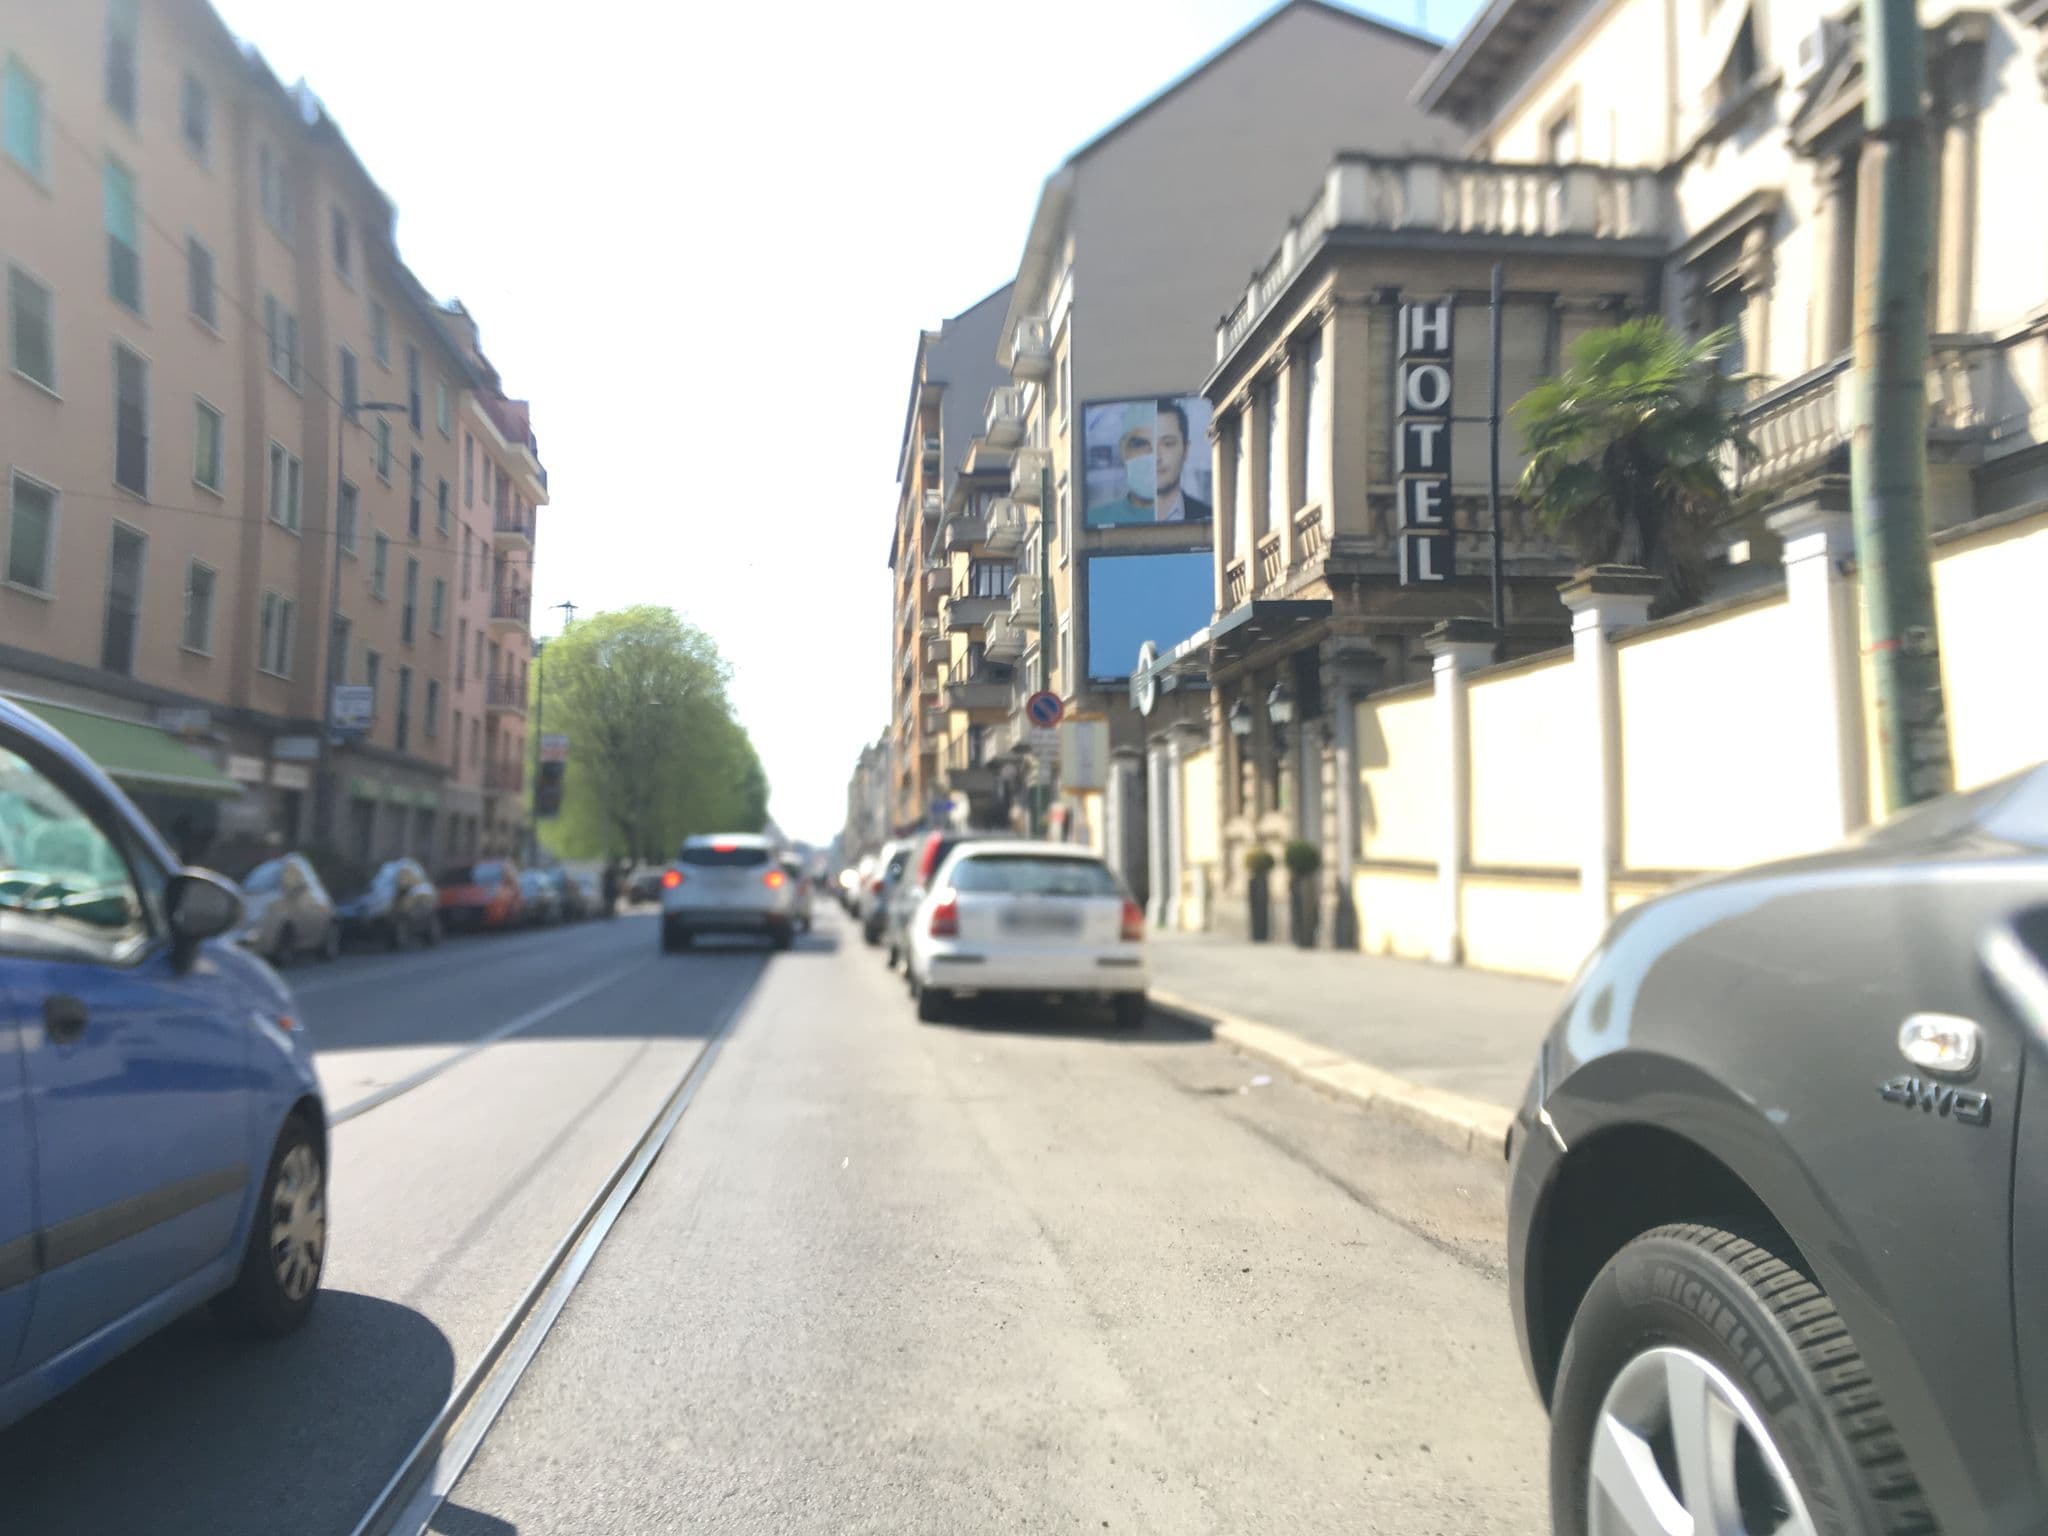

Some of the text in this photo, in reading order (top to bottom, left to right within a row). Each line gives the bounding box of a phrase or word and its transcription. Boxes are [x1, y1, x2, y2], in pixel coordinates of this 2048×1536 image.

[1406, 305, 1451, 582] HOTEL
[1879, 1075, 1989, 1124] 4WD
[1653, 1266, 1788, 1405] MICHELIN
